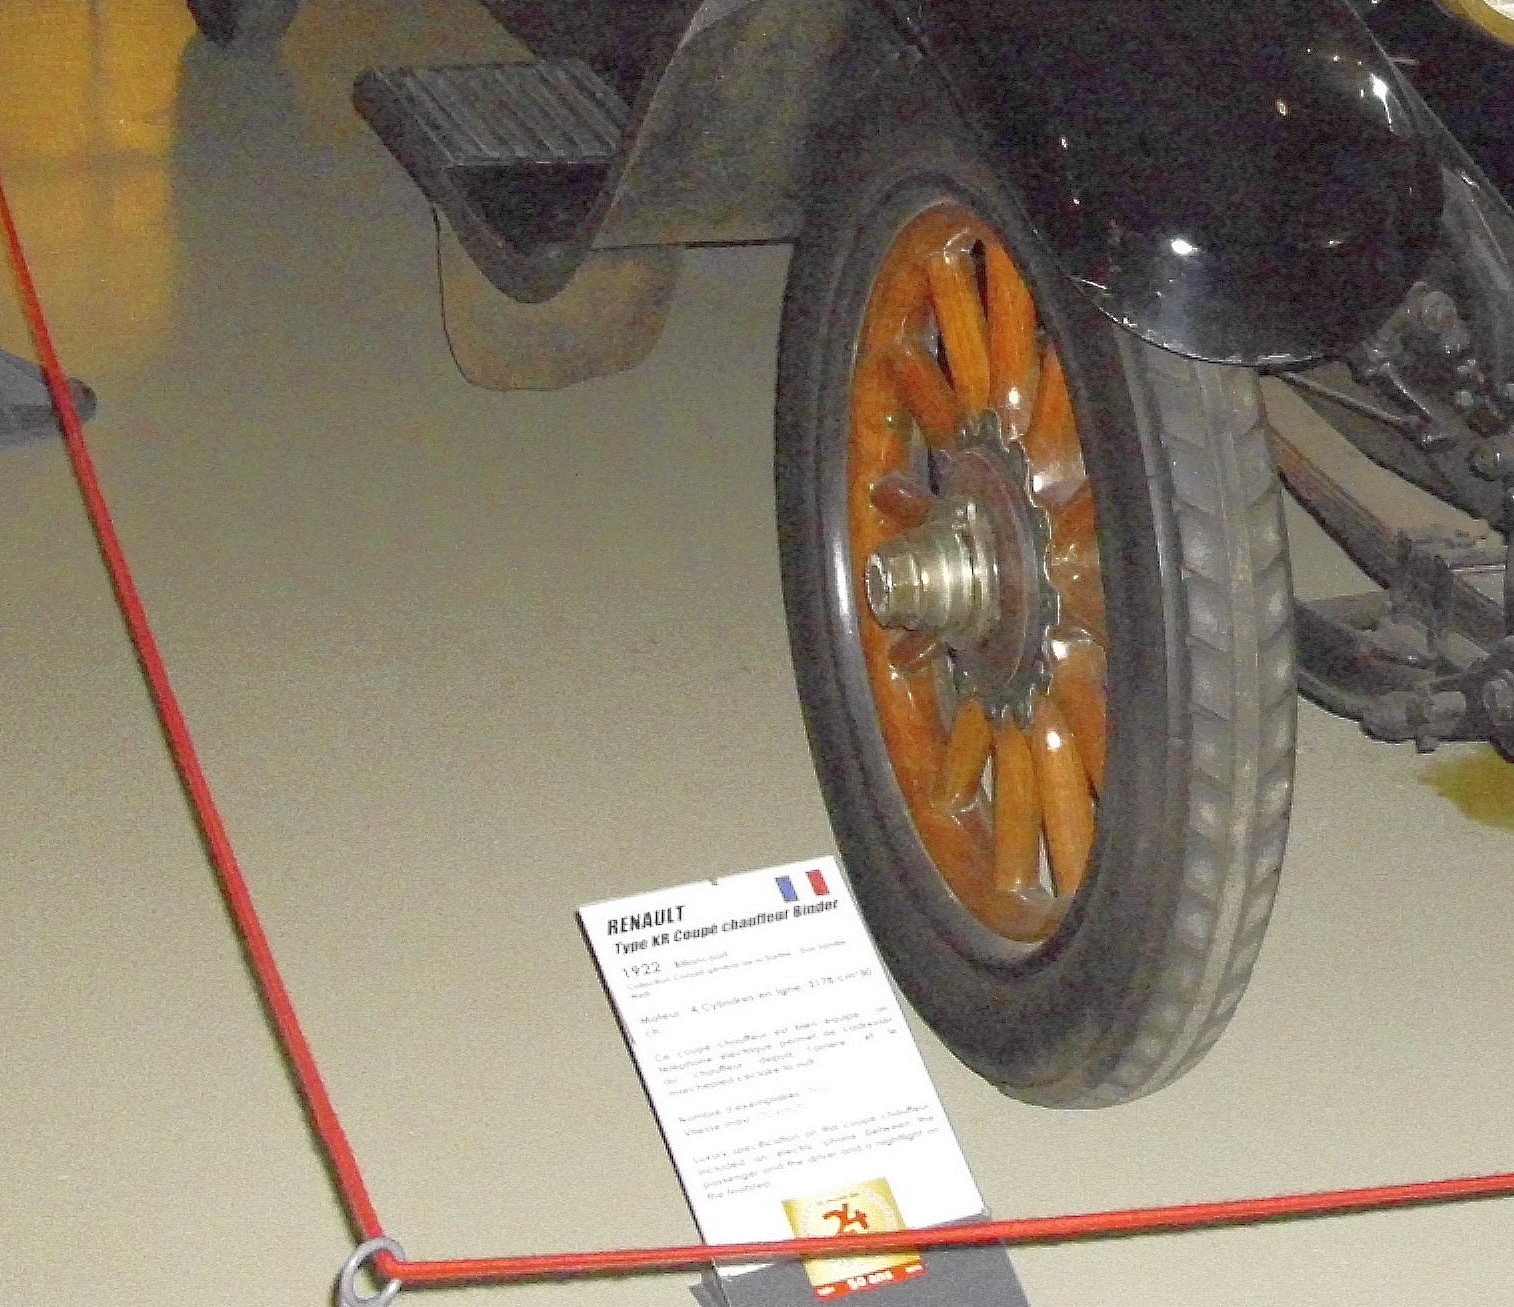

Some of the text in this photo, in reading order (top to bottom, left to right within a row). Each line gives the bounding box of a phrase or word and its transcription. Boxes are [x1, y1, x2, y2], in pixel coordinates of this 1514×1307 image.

[607, 904, 686, 936] RENAULT
[615, 941, 649, 956] Type
[793, 898, 839, 918] Binder
[622, 961, 662, 979] 1922
